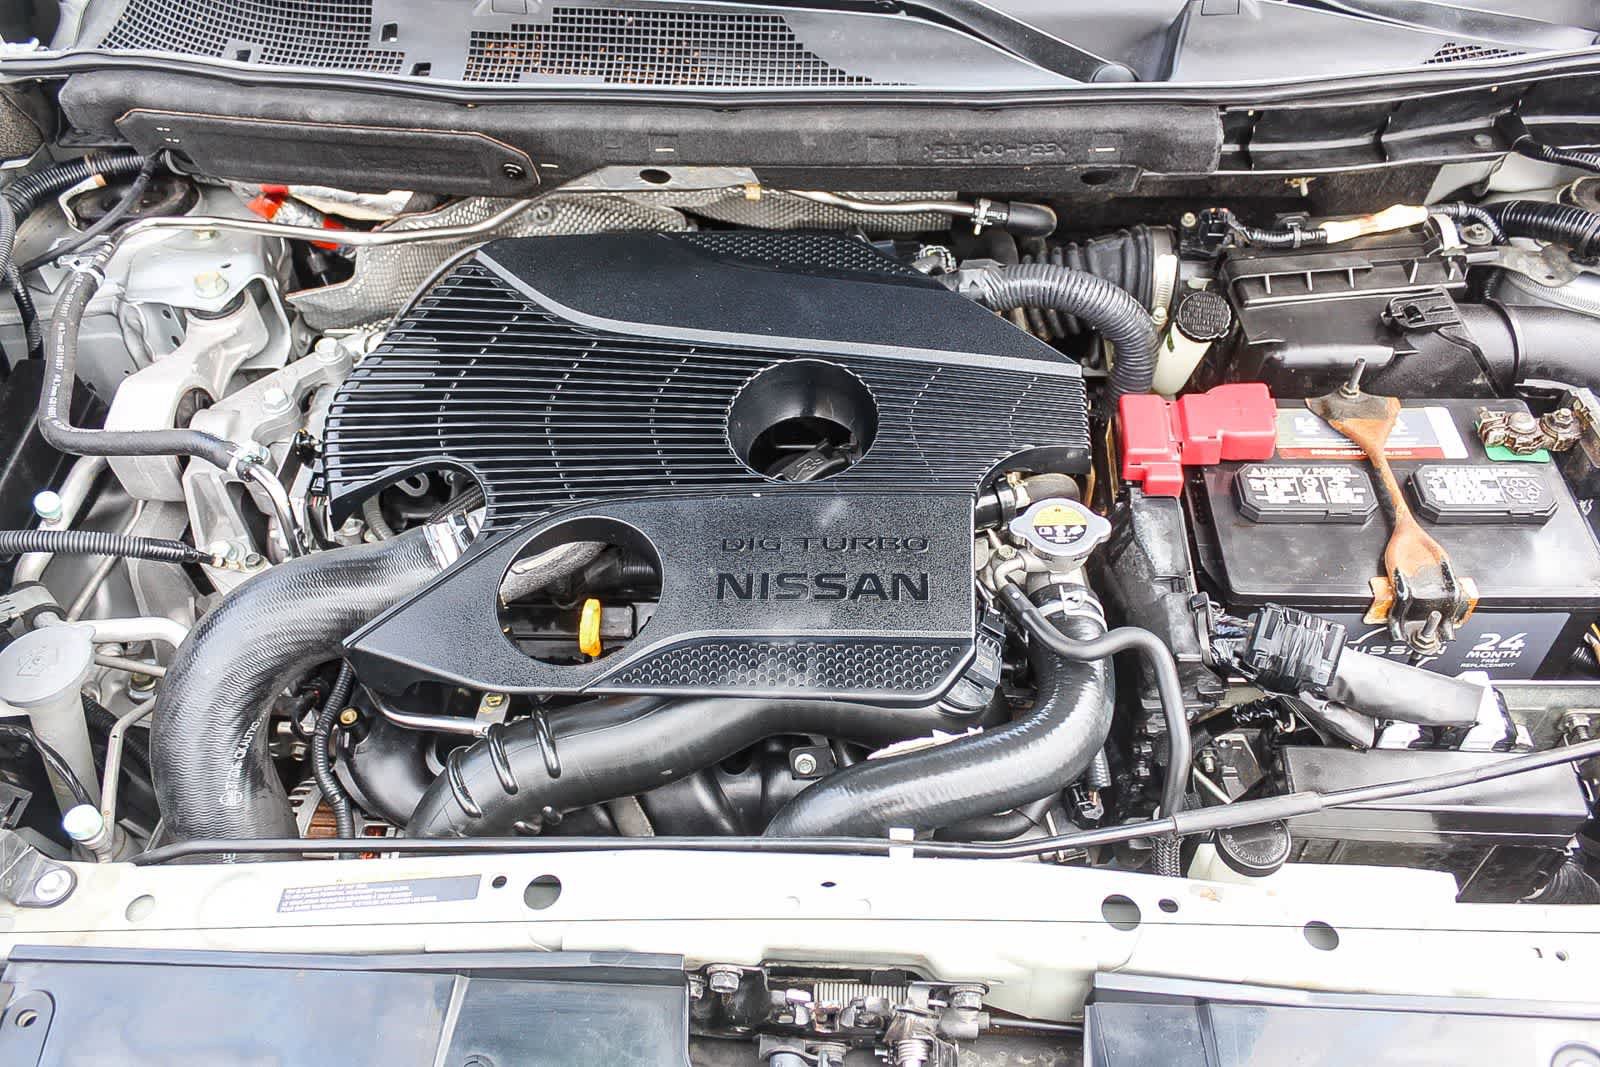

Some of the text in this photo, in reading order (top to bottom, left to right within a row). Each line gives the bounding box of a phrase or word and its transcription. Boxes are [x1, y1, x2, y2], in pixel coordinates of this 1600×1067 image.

[722, 537, 930, 553] DIG TURBO
[716, 571, 930, 601] NISSAN
[1472, 632, 1528, 651] 24
[1465, 650, 1522, 659] MONTH
